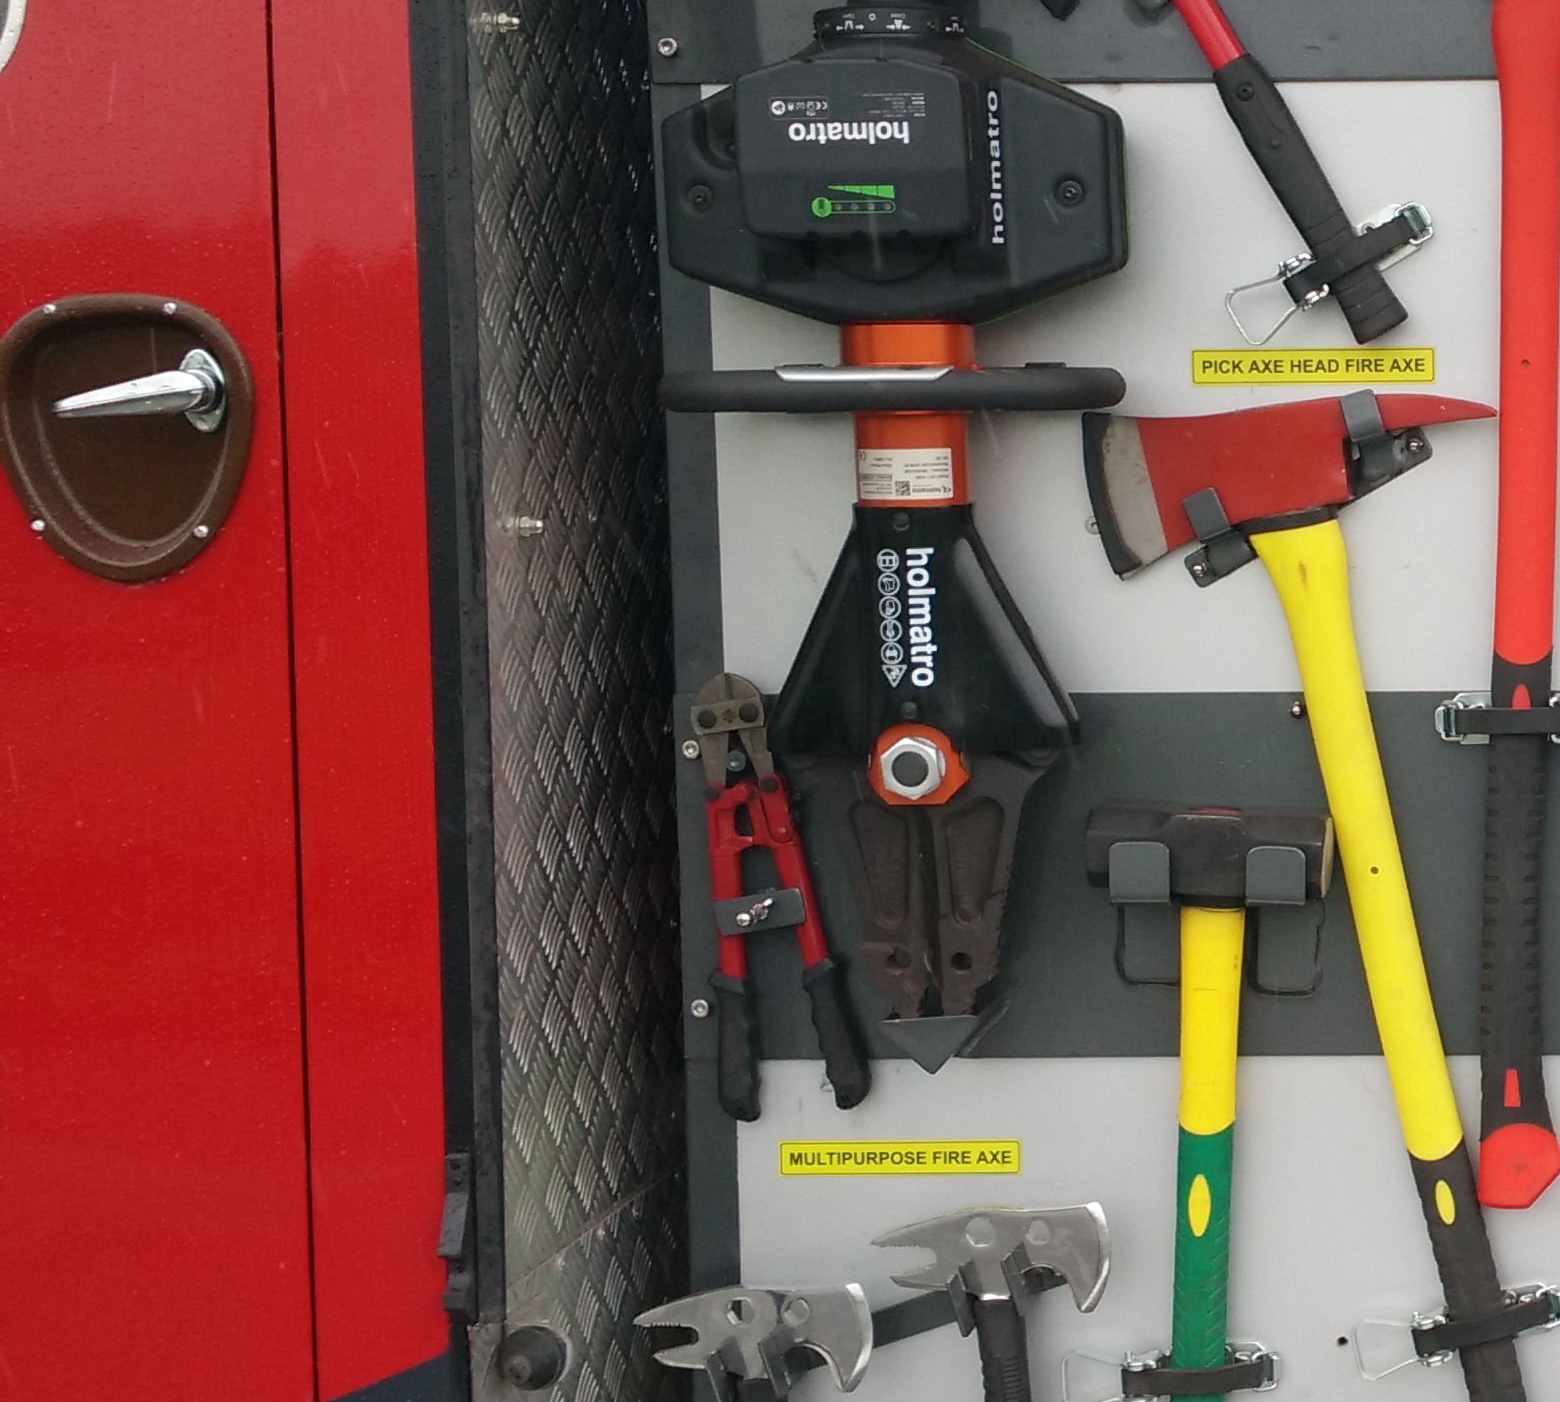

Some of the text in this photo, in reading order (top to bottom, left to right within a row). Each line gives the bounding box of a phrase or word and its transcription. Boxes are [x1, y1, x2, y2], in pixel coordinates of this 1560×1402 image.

[788, 121, 910, 144] holmatro
[987, 90, 1005, 245] holmatro
[1202, 358, 1425, 374] PICK AXE HEAD FIRE AXE
[905, 547, 937, 687] holmatro
[790, 1150, 1012, 1165] MULTIPURPOSE FIRE AXE
